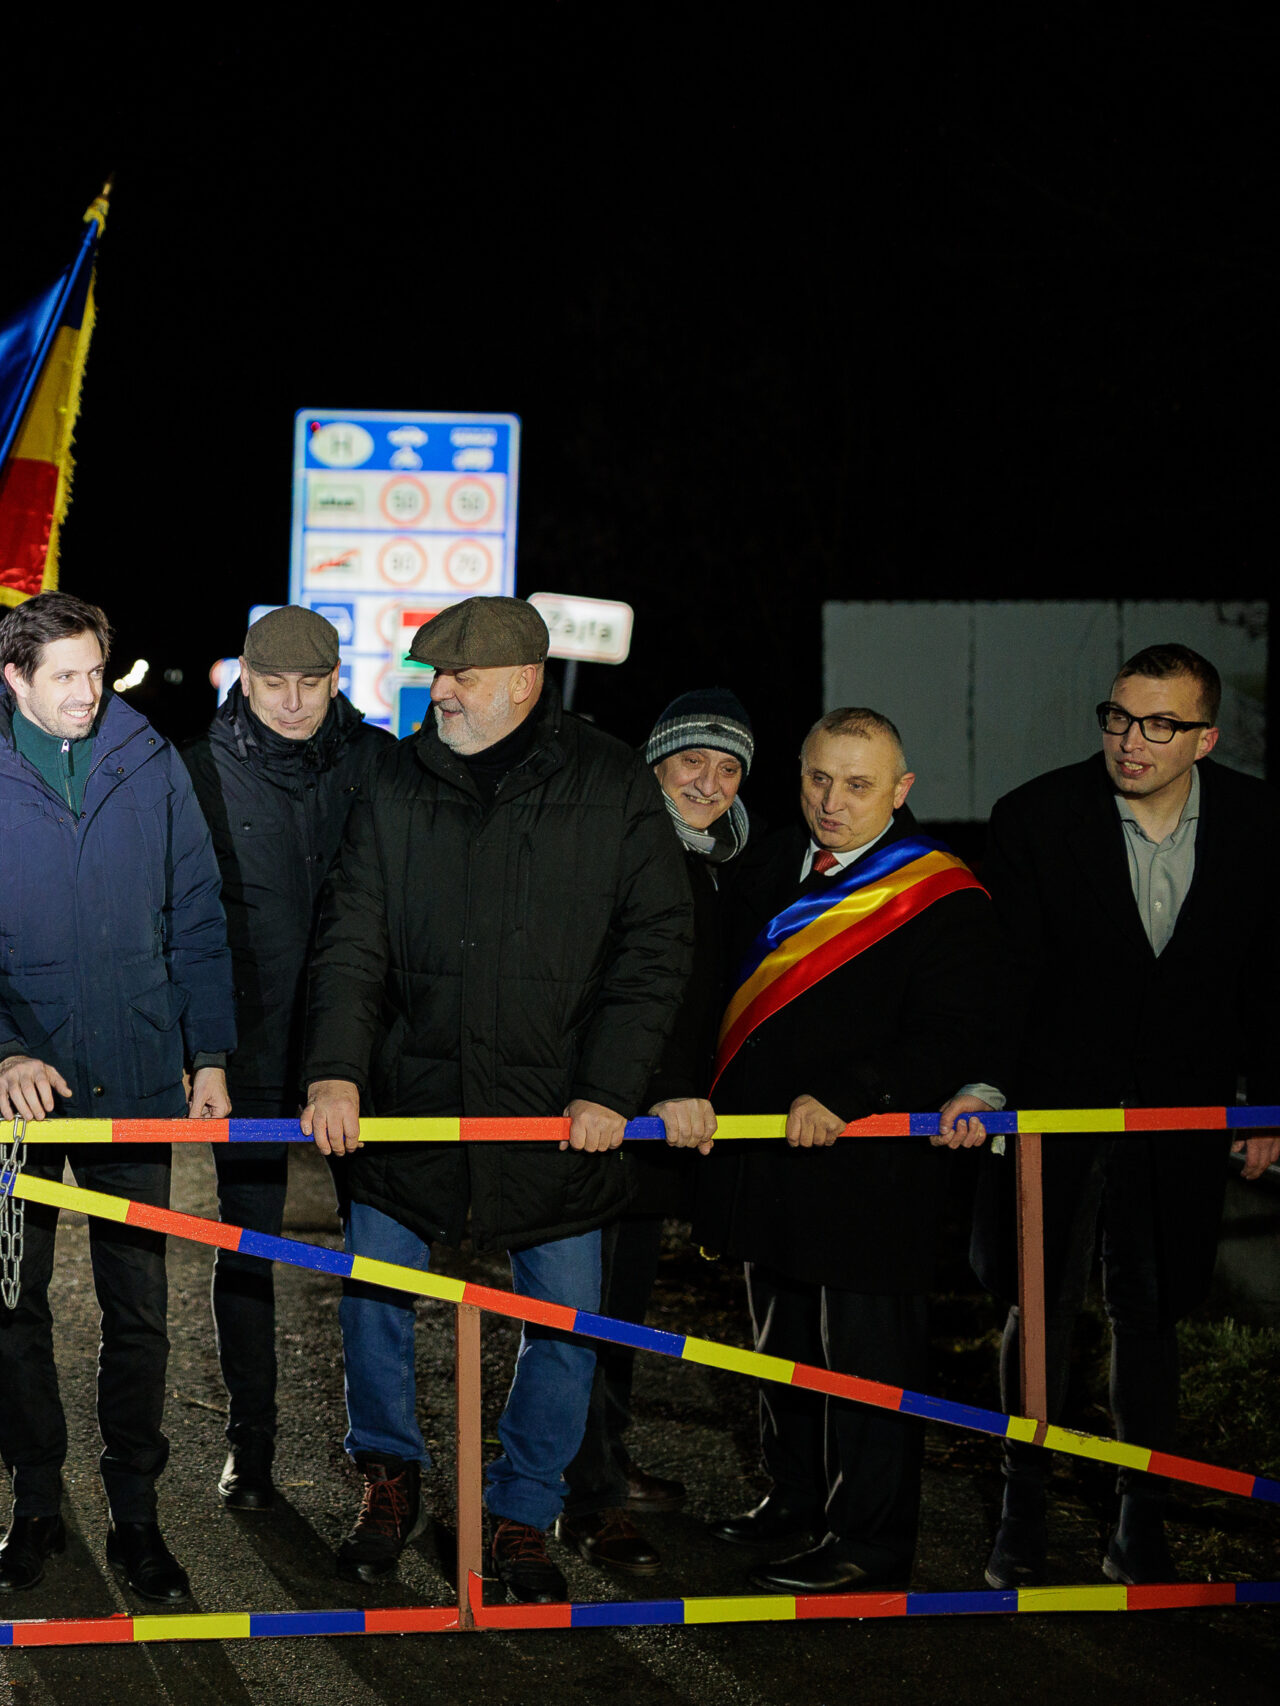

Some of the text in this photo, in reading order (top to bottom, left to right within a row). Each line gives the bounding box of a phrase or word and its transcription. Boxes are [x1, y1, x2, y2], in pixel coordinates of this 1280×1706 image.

[330, 431, 353, 458] H
[392, 489, 419, 513] 50
[458, 489, 484, 513] 50
[549, 609, 613, 643] Zajta
